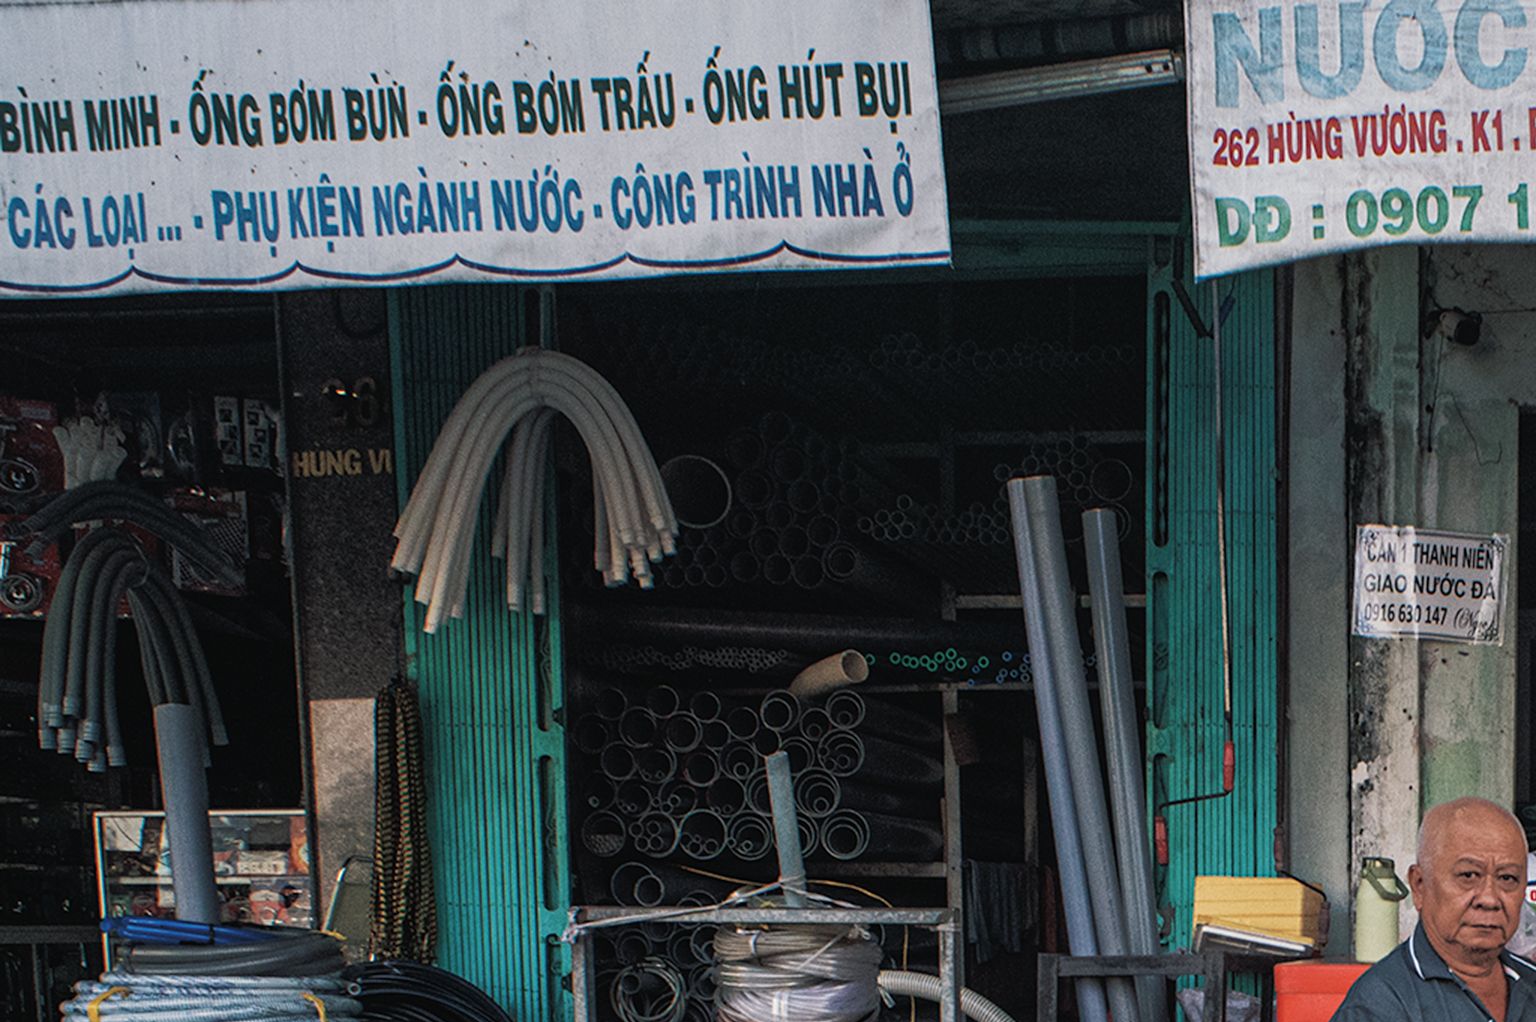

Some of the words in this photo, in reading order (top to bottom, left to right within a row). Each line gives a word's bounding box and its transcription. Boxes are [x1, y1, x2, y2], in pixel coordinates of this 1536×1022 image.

[0, 86, 77, 153] BÌNH
[84, 95, 161, 153] MINH
[189, 69, 262, 148] ỐNG
[269, 80, 336, 145] BƠM
[345, 73, 409, 142] BÙN
[437, 60, 506, 137] ỐNG
[512, 70, 586, 135] BƠM
[591, 50, 676, 131] TRẤU
[703, 46, 770, 125] ỐNG
[778, 48, 844, 120] HÚT
[855, 61, 912, 134] BỤI
[1213, 127, 1260, 168] 262
[1267, 111, 1344, 165] HÙNG
[1350, 103, 1447, 158] VƯƠNG
[1471, 109, 1504, 153] K1
[7, 183, 76, 249] CÁC
[82, 192, 148, 259] LOẠI
[211, 189, 281, 257] PHỤ
[287, 173, 361, 252] KIỆN
[372, 166, 483, 237] NGÀNH
[490, 164, 585, 233] NƯỚC
[610, 163, 696, 231] CÔNG
[703, 151, 802, 221] TRÌNH
[811, 147, 885, 218] NHÀ
[893, 141, 914, 218] Ở
[1345, 185, 1483, 238] 0907
[1413, 543, 1459, 566] THANH
[1364, 574, 1407, 593] GIAO
[1413, 572, 1466, 598] NƯỚC
[1364, 603, 1395, 622] 0916
[1398, 604, 1422, 623] 630
[1425, 606, 1448, 626] 147
